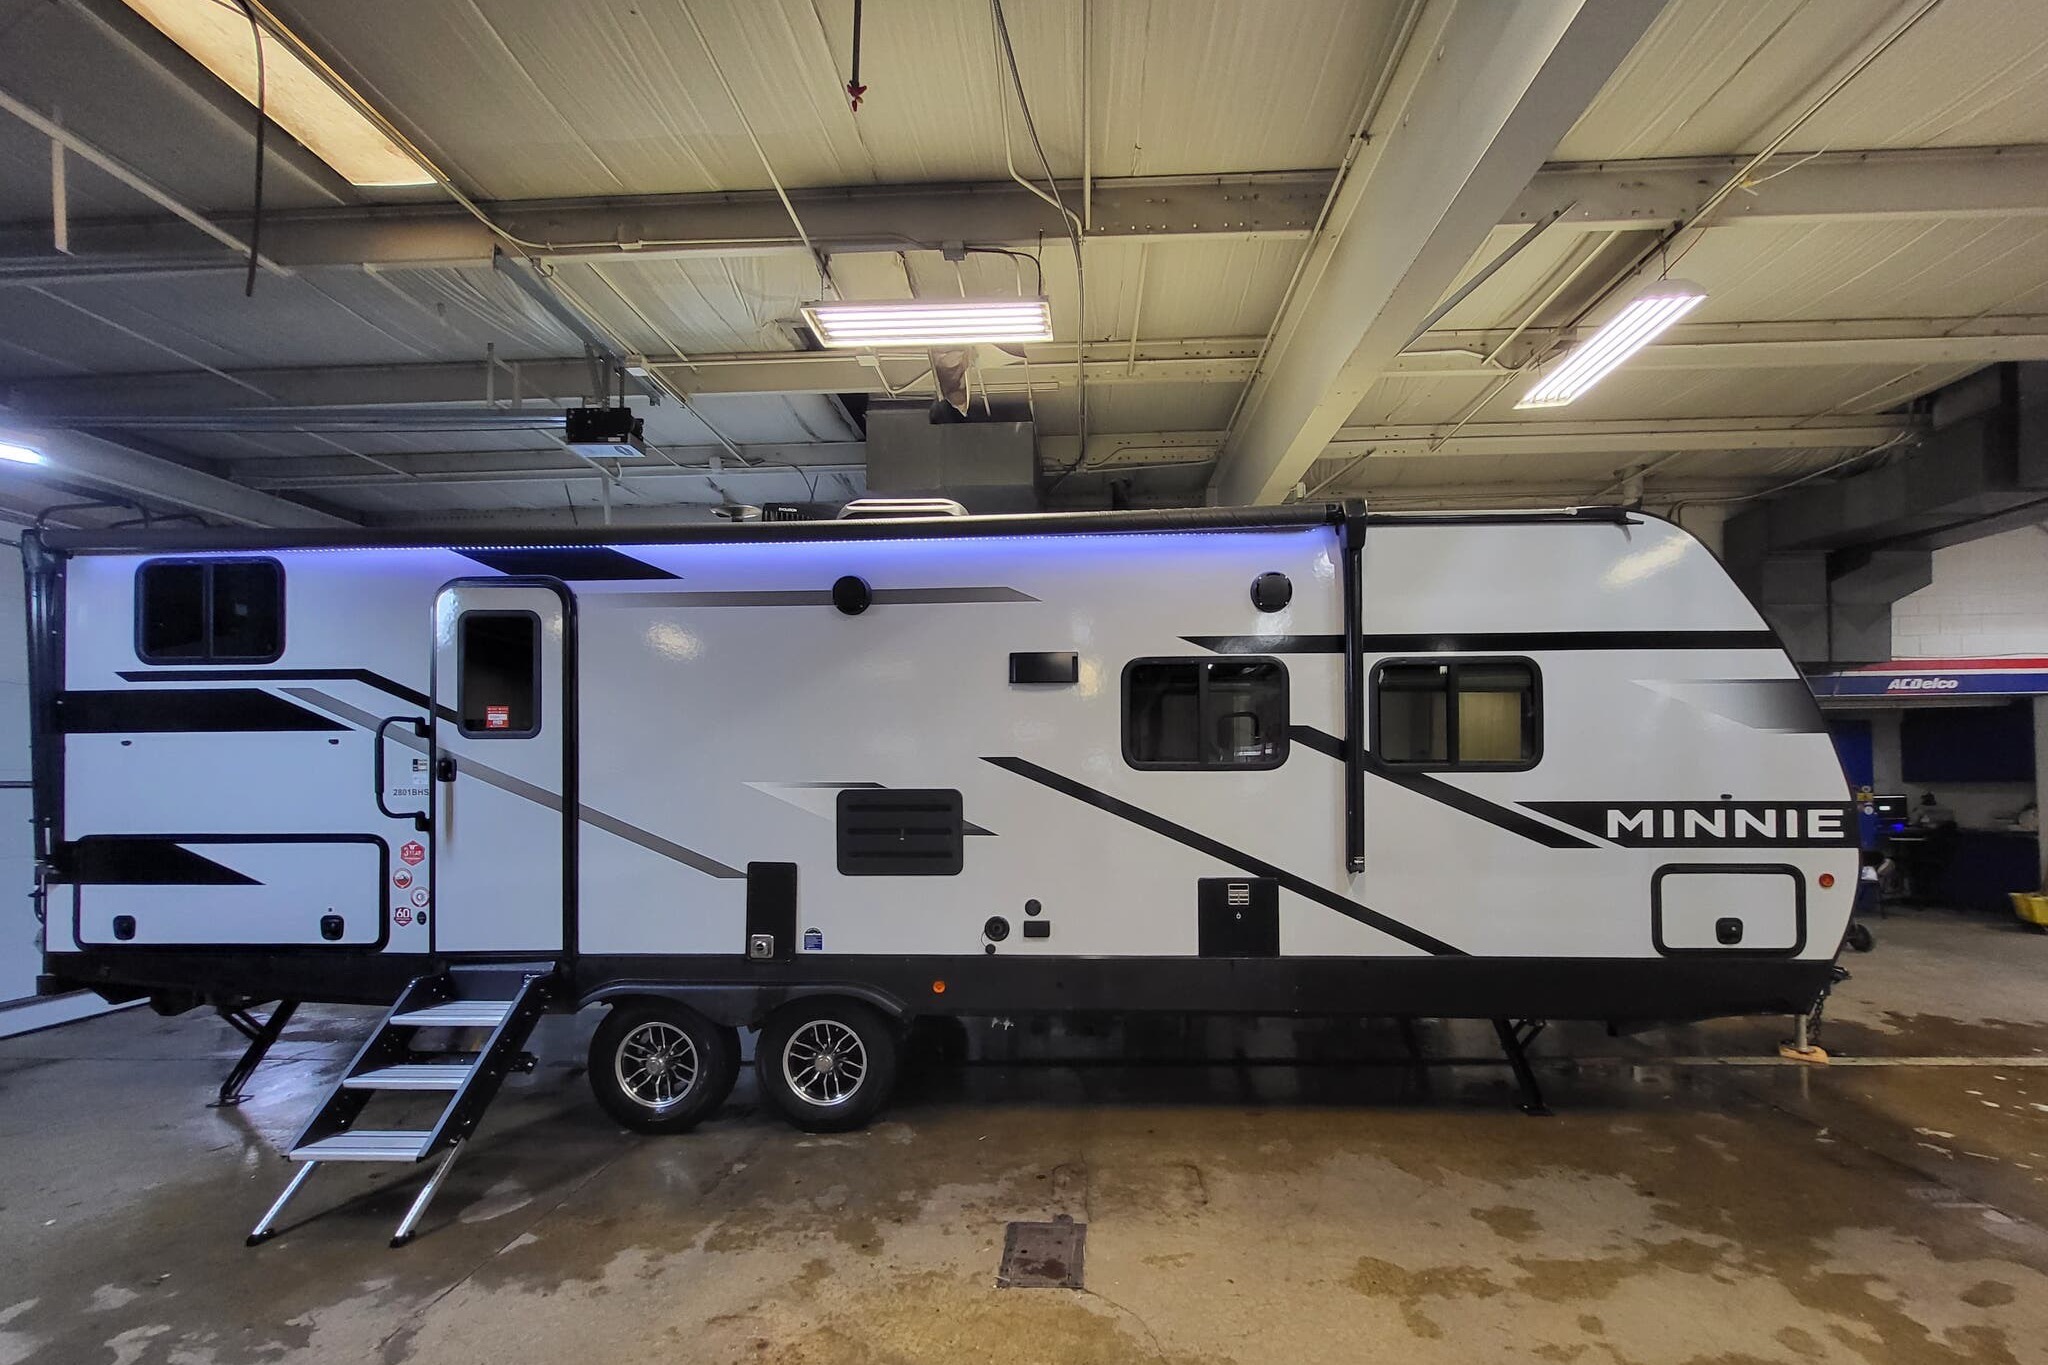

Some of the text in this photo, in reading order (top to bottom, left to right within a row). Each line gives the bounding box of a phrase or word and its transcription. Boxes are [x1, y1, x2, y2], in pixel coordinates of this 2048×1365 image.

[1887, 678, 1959, 690] ACDelco
[393, 788, 429, 796] 2801BHS
[1607, 809, 1844, 838] MINNIE
[403, 846, 409, 857] 3
[396, 908, 410, 918] 60
